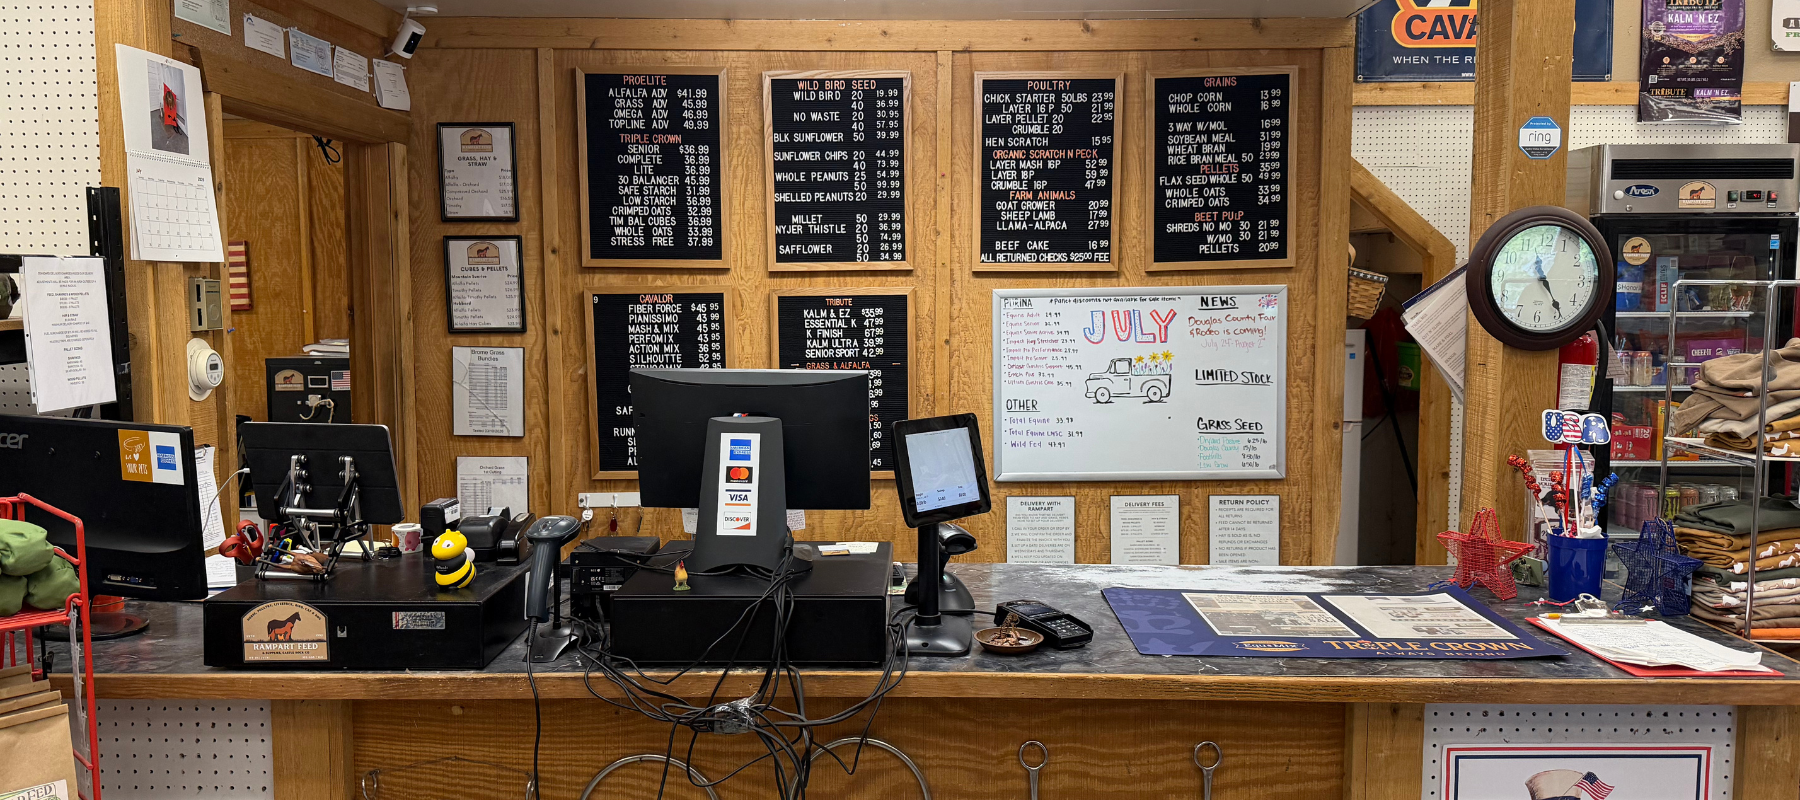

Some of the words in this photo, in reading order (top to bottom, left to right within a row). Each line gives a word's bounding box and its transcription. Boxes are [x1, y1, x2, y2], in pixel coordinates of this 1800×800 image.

[1668, 14, 1692, 23] KALM
[1708, 14, 1719, 23] EZ
[1393, 56, 1429, 64] WHEN
[1434, 56, 1459, 64] THE
[624, 76, 666, 85] PROELITE
[798, 81, 818, 90] WILD
[825, 80, 845, 90] BIRD
[852, 80, 876, 89] SEED
[1028, 81, 1070, 90] POULTRY
[1205, 77, 1236, 86] GRAINS
[609, 88, 647, 97] ALFALFA
[652, 89, 667, 97] ADV
[677, 89, 706, 98] $41.99
[794, 91, 816, 100] WILD
[819, 91, 840, 100] BIRD
[852, 91, 863, 100] 20
[877, 89, 898, 97] 19.99
[1169, 93, 1192, 102] CHOP
[1198, 92, 1222, 101] CORN
[1650, 88, 1687, 96] TRIBUTE
[984, 94, 1010, 103] CHICK
[1016, 94, 1055, 102] STARTER
[1062, 93, 1087, 102] 50LBS
[1169, 123, 1173, 132] 3
[1176, 122, 1192, 131] WAY
[1197, 122, 1227, 130] W/MOL
[620, 134, 649, 143] TRIPLE
[653, 135, 681, 143] CROWN
[774, 133, 789, 142] BLK
[794, 133, 843, 142] SUNFLOWER
[854, 132, 864, 141] 50
[986, 138, 1004, 146] HEN
[1008, 137, 1048, 146] SCRATCH
[1168, 135, 1206, 144] SOYBEAN
[1212, 134, 1235, 142] MEAL
[1529, 131, 1551, 144] ring
[628, 145, 659, 153] SENIOR
[679, 145, 708, 154] $36.99
[1168, 145, 1197, 154] WHEAT
[1203, 144, 1225, 153] BRAN
[618, 155, 662, 164] COMPLETE
[685, 155, 709, 164] 36.99
[1201, 164, 1238, 173] PELLETS
[619, 186, 639, 194] SAFE
[643, 186, 676, 195] STARCH
[686, 186, 710, 195] 31.99
[1010, 191, 1032, 200] FARM
[1038, 191, 1075, 200] ANIMALS
[774, 192, 812, 202] SHELLED
[815, 192, 853, 202] PEANUTS
[856, 192, 866, 201] 20
[878, 191, 900, 200] 29.99
[996, 201, 1018, 210] GOAT
[1021, 201, 1055, 210] GROWER
[1166, 198, 1204, 208] CRIMPED
[1209, 198, 1229, 206] OATS
[792, 215, 822, 224] MILLET
[997, 221, 1067, 230] LLAMA-ALPACA
[611, 237, 644, 246] STRESS
[653, 237, 674, 246] FREE
[688, 238, 712, 246] 37.99
[996, 241, 1019, 250] BEEF
[1027, 241, 1049, 250] CAKE
[1520, 239, 1530, 251] 11
[1540, 234, 1554, 247] 12
[780, 244, 832, 254] SAFFLOWER
[1561, 240, 1567, 252] 1
[1504, 252, 1517, 264] 10
[1573, 254, 1580, 267] 2
[1498, 270, 1504, 282] 9
[1578, 275, 1585, 288] 3
[640, 294, 673, 303] CAVALOR
[1501, 290, 1508, 302] 8
[1570, 293, 1577, 306] 4
[826, 298, 852, 306] TRIBUTE
[1200, 296, 1237, 307] NEWS
[629, 304, 650, 313] FIBER
[656, 304, 682, 313] FORCE
[804, 309, 827, 318] KALM
[830, 309, 836, 318] &
[840, 309, 850, 318] EZ
[1516, 305, 1523, 318] 7
[1554, 307, 1561, 320] 5
[629, 314, 678, 323] PIANISSIMO
[1188, 316, 1222, 327] Douglas
[1224, 313, 1256, 324] County
[1258, 314, 1276, 322] Fair
[1534, 310, 1540, 323] 6
[629, 325, 651, 333] MASH
[654, 324, 660, 333] &
[664, 324, 679, 333] MIX
[805, 319, 848, 328] ESSENTIAL
[851, 319, 856, 327] K
[1083, 309, 1177, 344] JULY
[1196, 327, 1220, 336] Rodeo
[1223, 326, 1230, 335] is
[1234, 326, 1267, 337] coming!
[629, 334, 673, 343] PERFOMIX
[806, 349, 834, 358] SENIOR
[836, 348, 860, 357] SPORT
[630, 354, 682, 363] SILHOUTTE
[806, 362, 829, 370] GRASS
[1196, 369, 1238, 382] LIMITED
[1242, 371, 1273, 384] STOCK
[1006, 400, 1038, 410] OTHER
[1197, 417, 1232, 430] GRASS
[1235, 420, 1263, 431] SEED
[1545, 412, 1609, 443] USA
[126, 463, 138, 473] YOUR
[139, 464, 148, 474] PETS
[1430, 642, 1534, 651] CROWN
